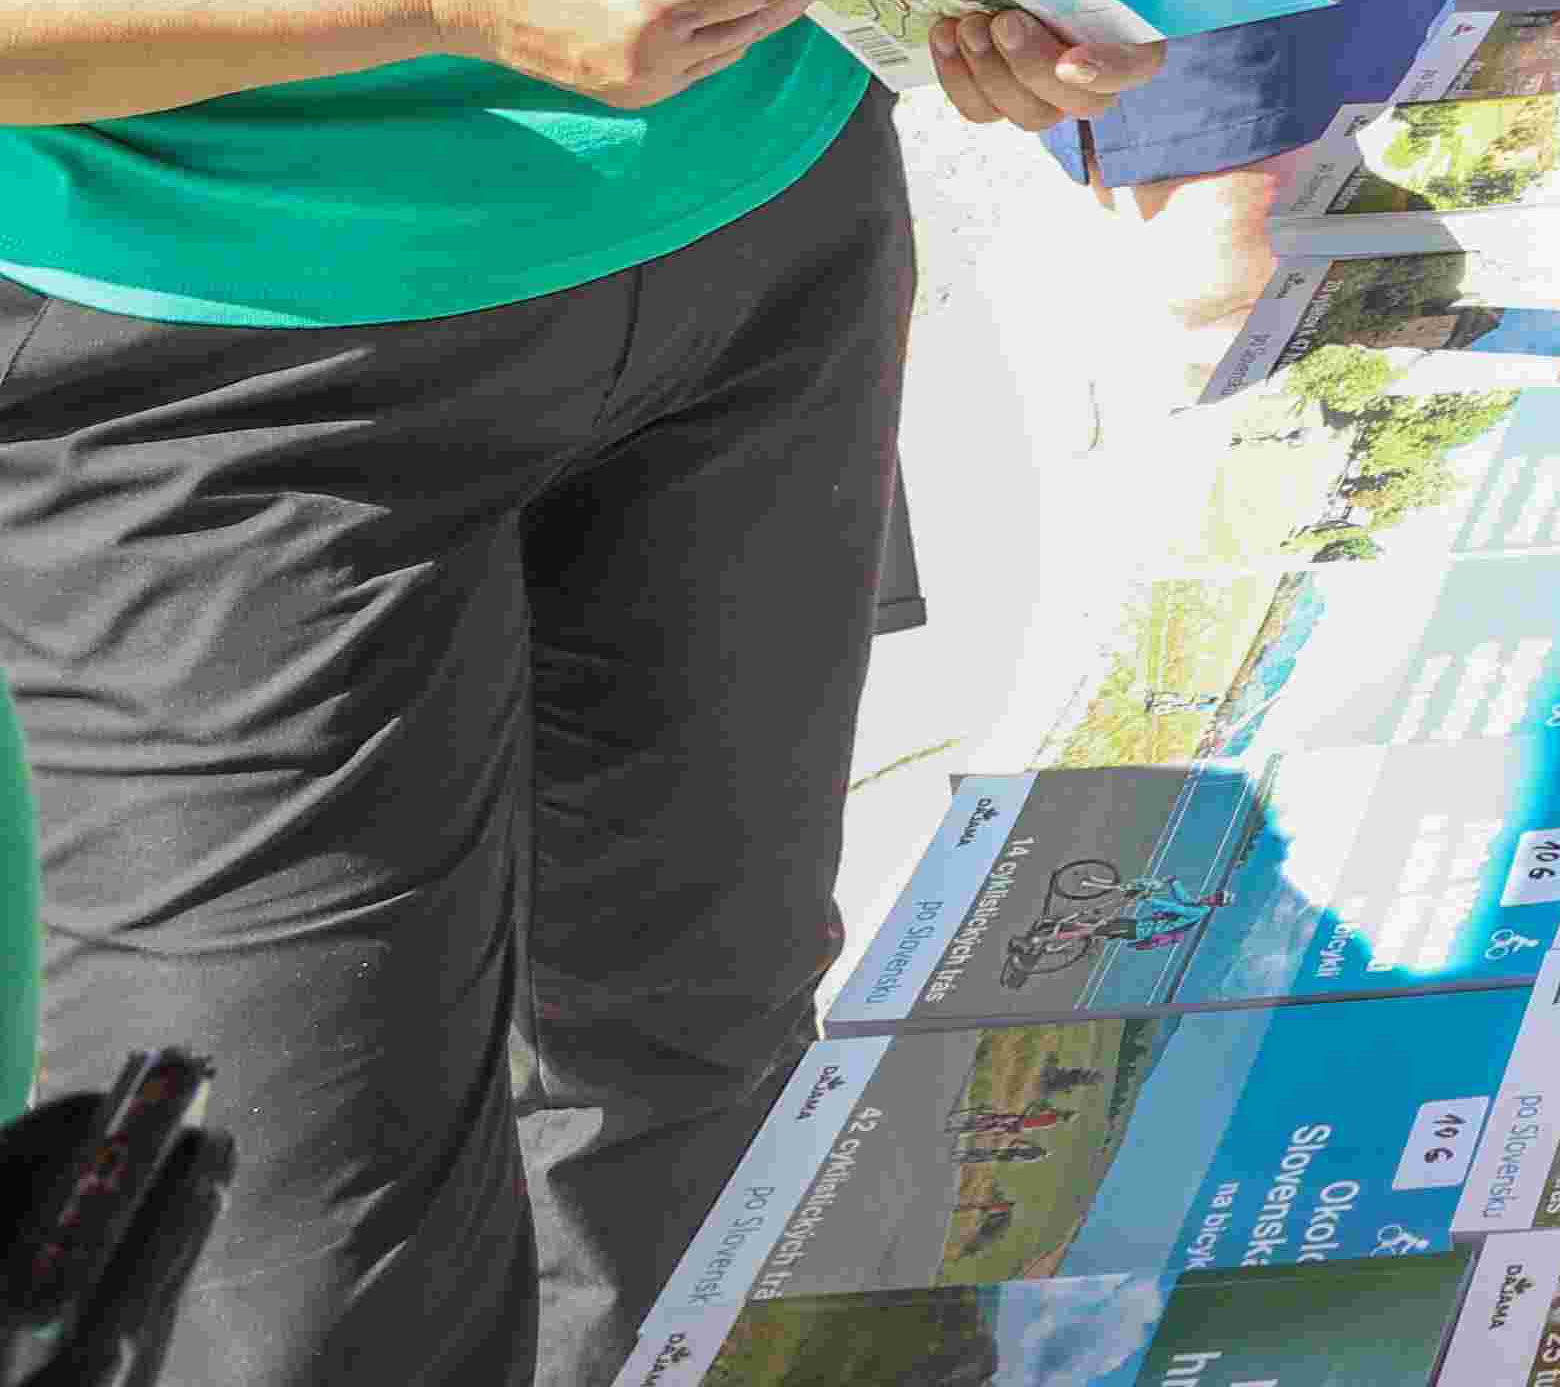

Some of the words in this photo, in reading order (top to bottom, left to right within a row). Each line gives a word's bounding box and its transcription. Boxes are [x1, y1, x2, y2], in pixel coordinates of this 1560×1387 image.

[954, 797, 993, 848] DAJAMA
[1005, 834, 1035, 857] 14
[912, 899, 946, 922] po
[941, 860, 1024, 965] cyklistických
[863, 924, 937, 1005] Slovensku
[923, 967, 961, 1004] trás
[795, 1065, 841, 1121] DAJAMA
[1513, 1092, 1545, 1119] po
[846, 1105, 884, 1133] 42
[1209, 1180, 1243, 1210] na
[1482, 1123, 1544, 1220] Slovensku
[739, 1184, 778, 1212] po
[770, 1136, 865, 1269] cyklistických
[686, 1215, 765, 1306] Slovensk
[1183, 1213, 1233, 1272] bicyk
[751, 1270, 786, 1302] trá
[1488, 1263, 1525, 1331] DAJAMA
